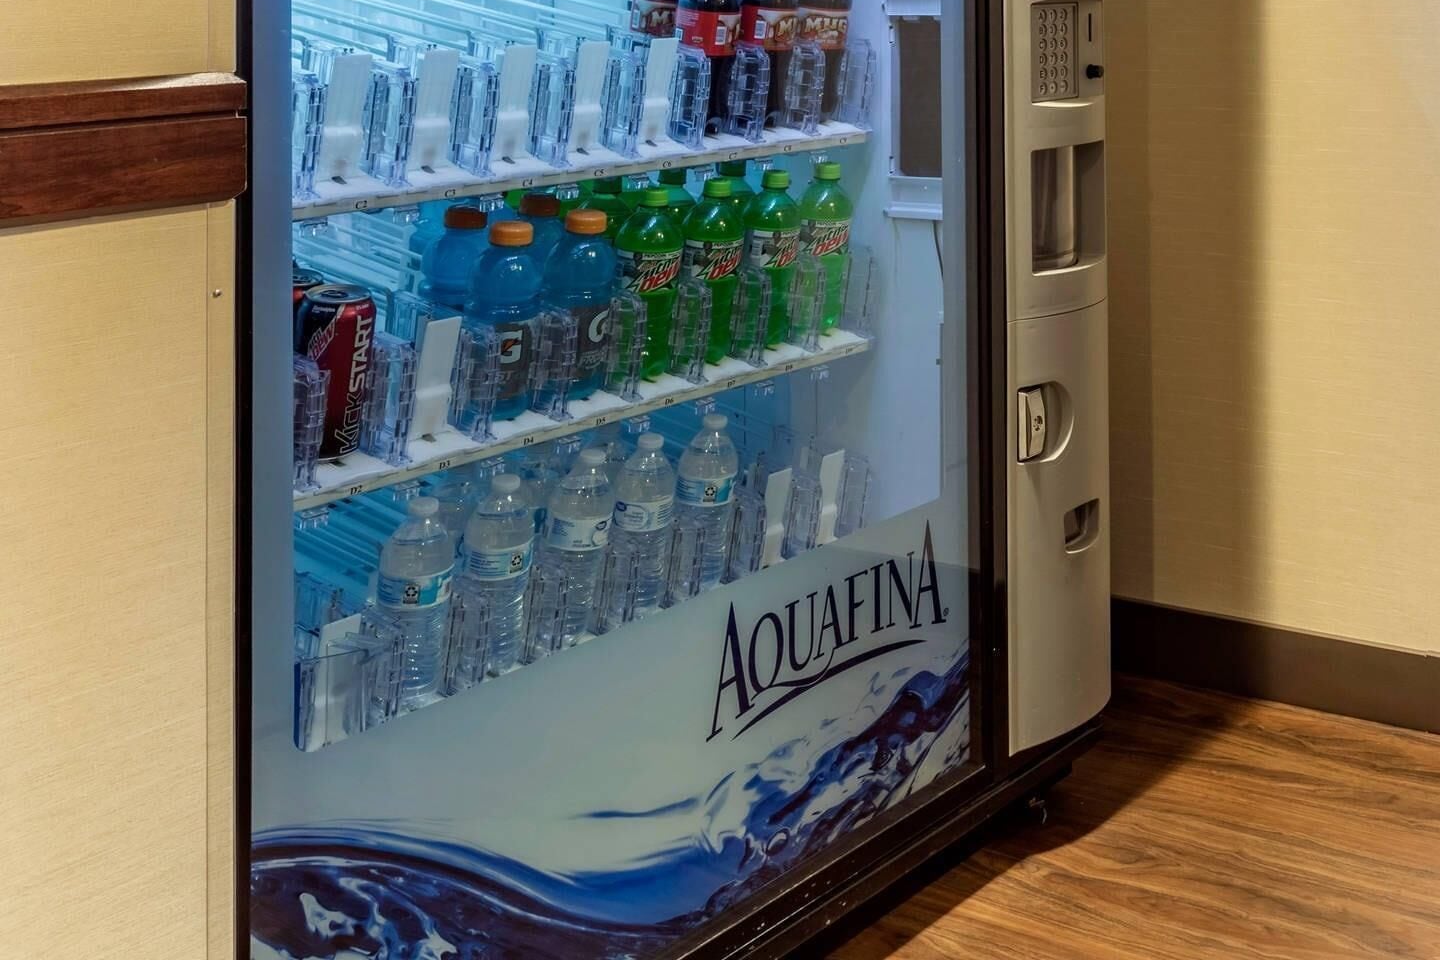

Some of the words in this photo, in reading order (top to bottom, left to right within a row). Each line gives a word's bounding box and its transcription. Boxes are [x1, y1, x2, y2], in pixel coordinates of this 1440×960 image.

[805, 16, 848, 33] MUG
[522, 178, 534, 189] C4
[444, 188, 457, 199] C3
[354, 199, 368, 211] C2
[499, 329, 522, 364] G
[522, 435, 535, 446] D4
[438, 460, 451, 470] D3
[349, 484, 363, 496] D2
[706, 520, 947, 741] AQUAFINA
